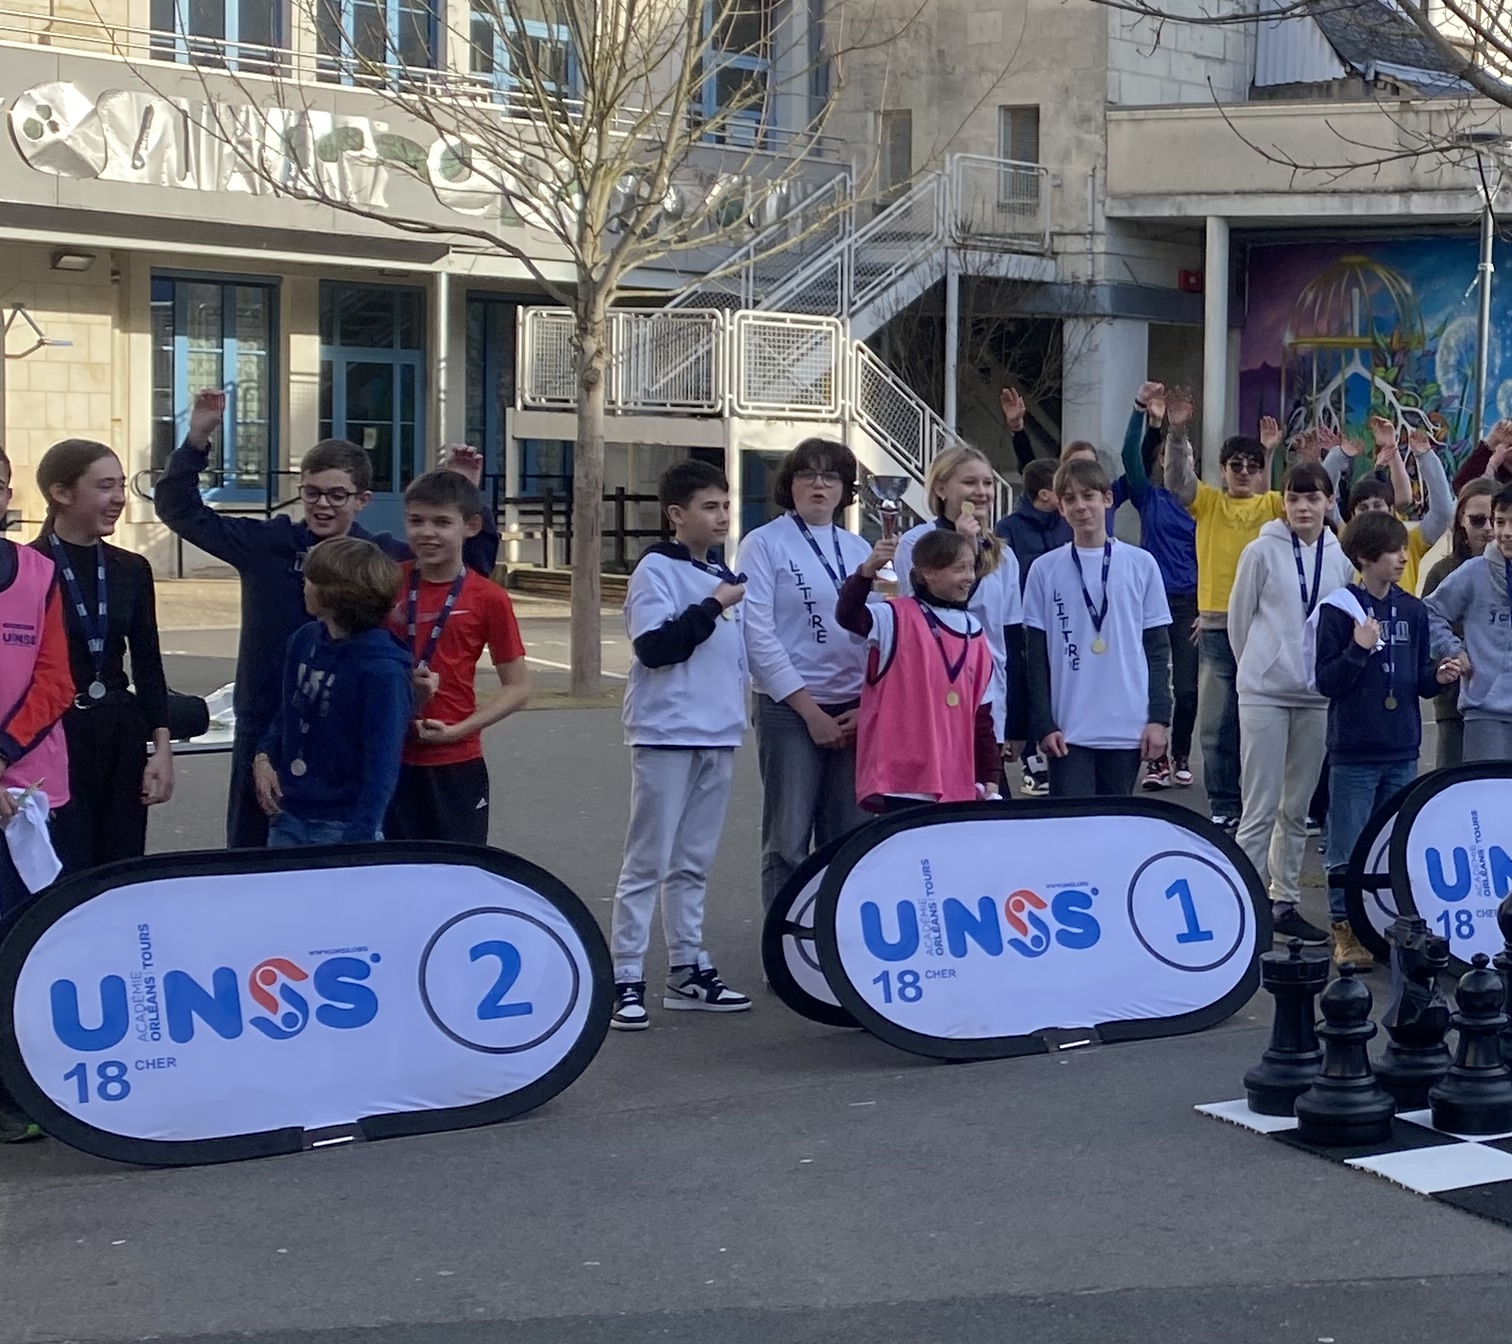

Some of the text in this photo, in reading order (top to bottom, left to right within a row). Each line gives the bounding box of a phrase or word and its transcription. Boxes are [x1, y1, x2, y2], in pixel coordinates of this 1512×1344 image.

[788, 559, 828, 644] LITTRE
[1053, 589, 1081, 672] LITTRE
[1470, 810, 1483, 845] TOURS
[860, 888, 1101, 962] UNSS
[917, 898, 934, 957] ACADÉMIE
[920, 858, 945, 956] ORLÉANS TOURS
[1164, 878, 1214, 944] 1
[1436, 908, 1475, 940] 18
[49, 957, 379, 1052] UNSS
[129, 971, 149, 1043] ACADÉMIE
[137, 923, 162, 1042] ORLÉANS TOURS
[468, 940, 533, 1021] 2
[872, 968, 957, 1004] 18 CHER
[63, 1056, 177, 1104] 18 CHER
